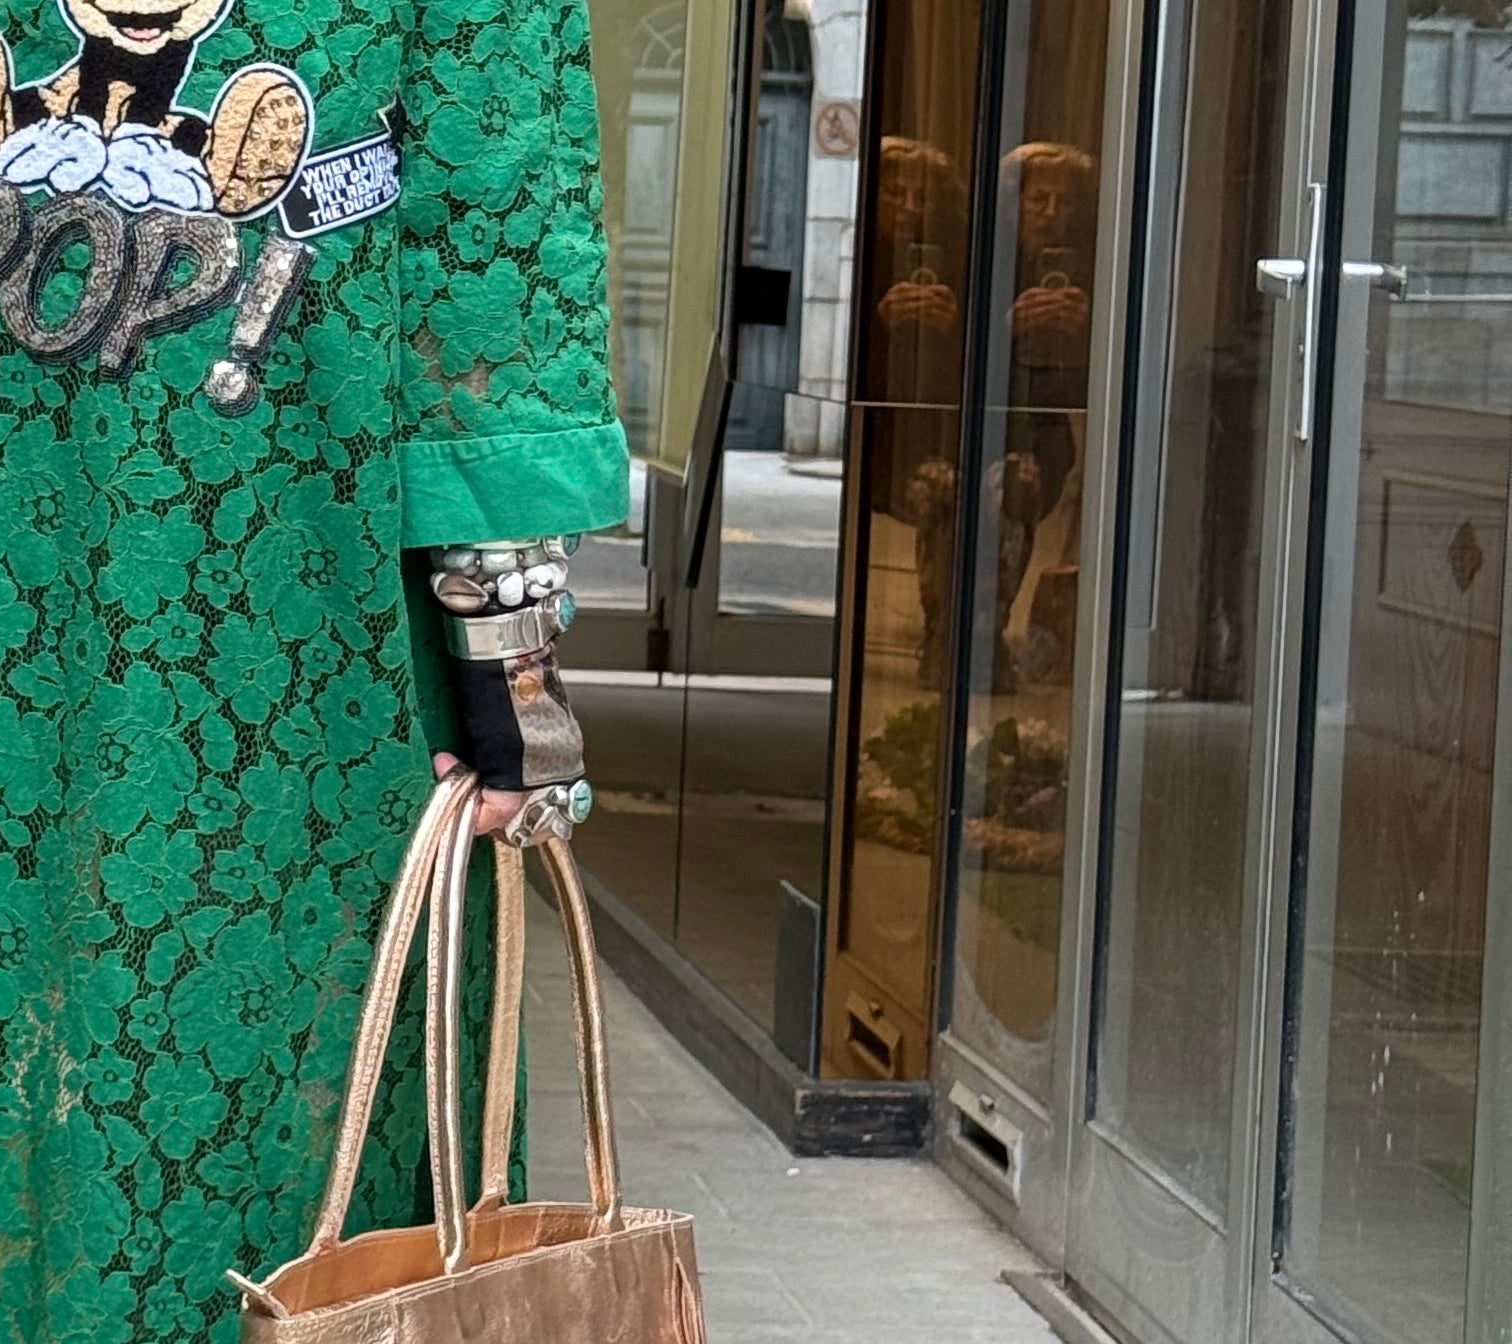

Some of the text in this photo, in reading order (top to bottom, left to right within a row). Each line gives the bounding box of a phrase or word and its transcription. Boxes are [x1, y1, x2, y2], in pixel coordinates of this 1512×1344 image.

[302, 157, 352, 185] WHEN
[354, 153, 362, 168] I
[300, 174, 346, 199] YOUR
[308, 204, 344, 226] THE
[343, 190, 381, 215] DUCT
